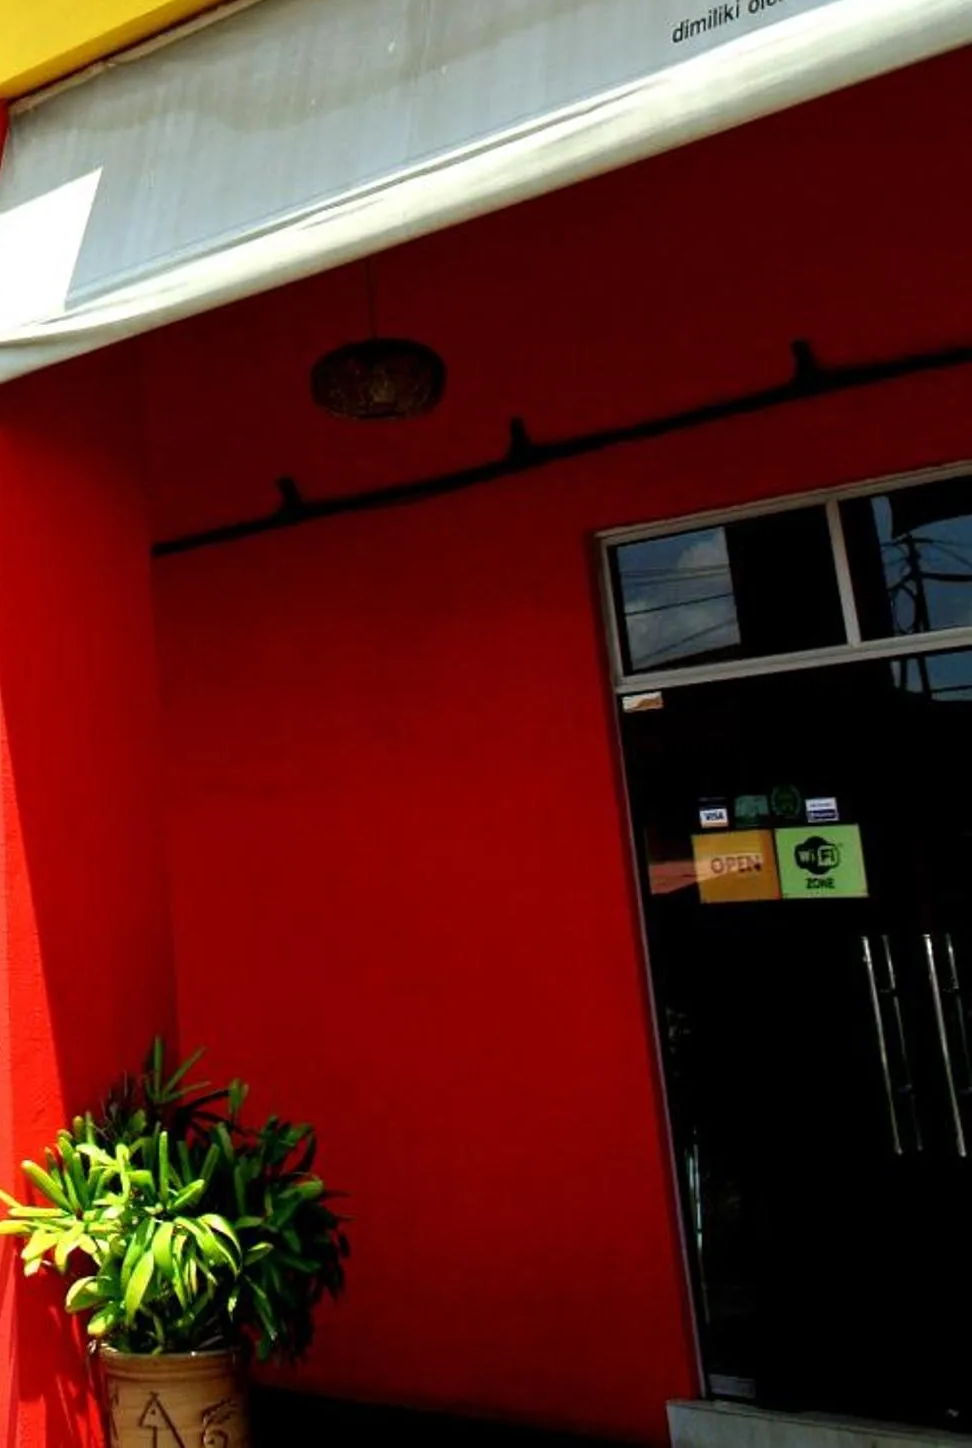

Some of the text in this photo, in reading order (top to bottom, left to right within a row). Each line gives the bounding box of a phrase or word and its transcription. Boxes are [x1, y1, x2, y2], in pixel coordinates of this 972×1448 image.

[704, 810, 724, 821] VISA
[710, 854, 762, 874] OPEN
[806, 878, 835, 890] ZONE
